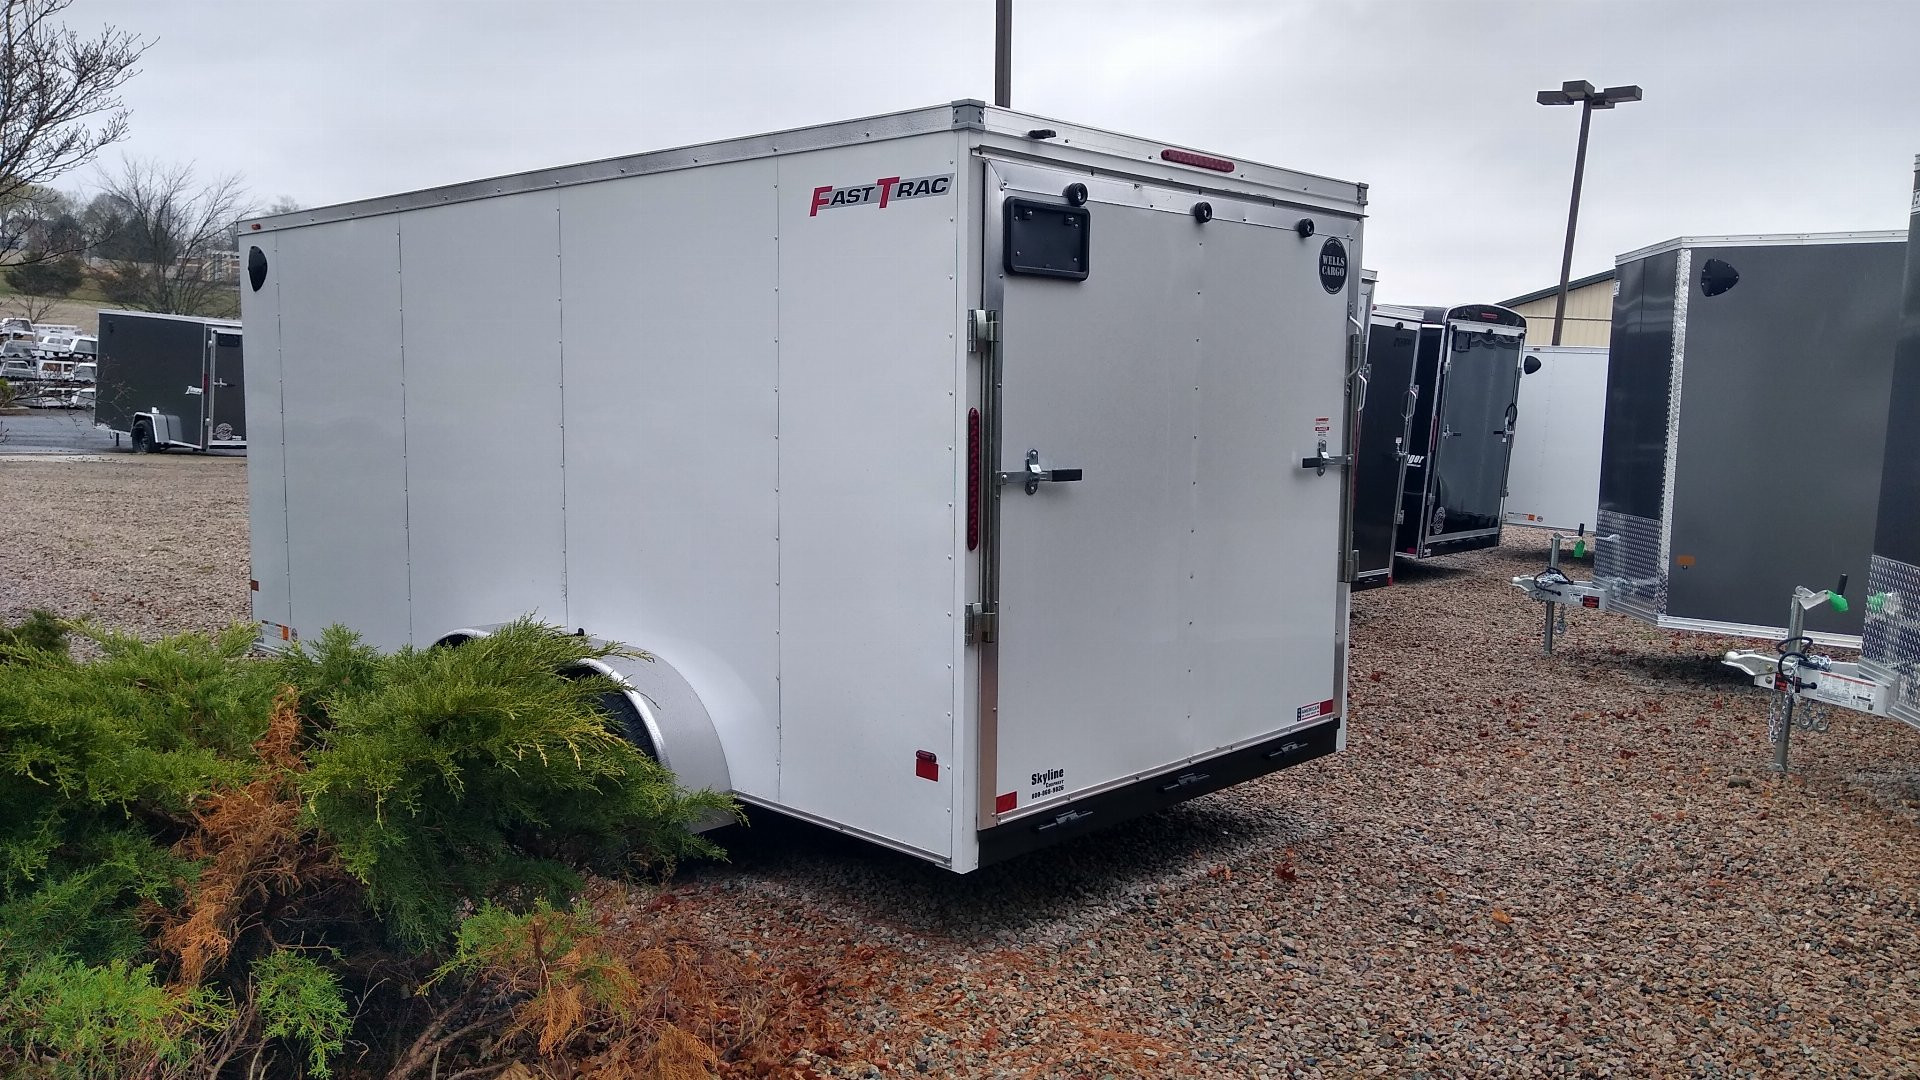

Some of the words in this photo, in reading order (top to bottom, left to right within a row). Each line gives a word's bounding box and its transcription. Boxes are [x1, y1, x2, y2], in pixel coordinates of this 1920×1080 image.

[1322, 254, 1345, 266] WELLS
[1321, 265, 1345, 277] CARGO
[1031, 768, 1064, 786] Skyline
